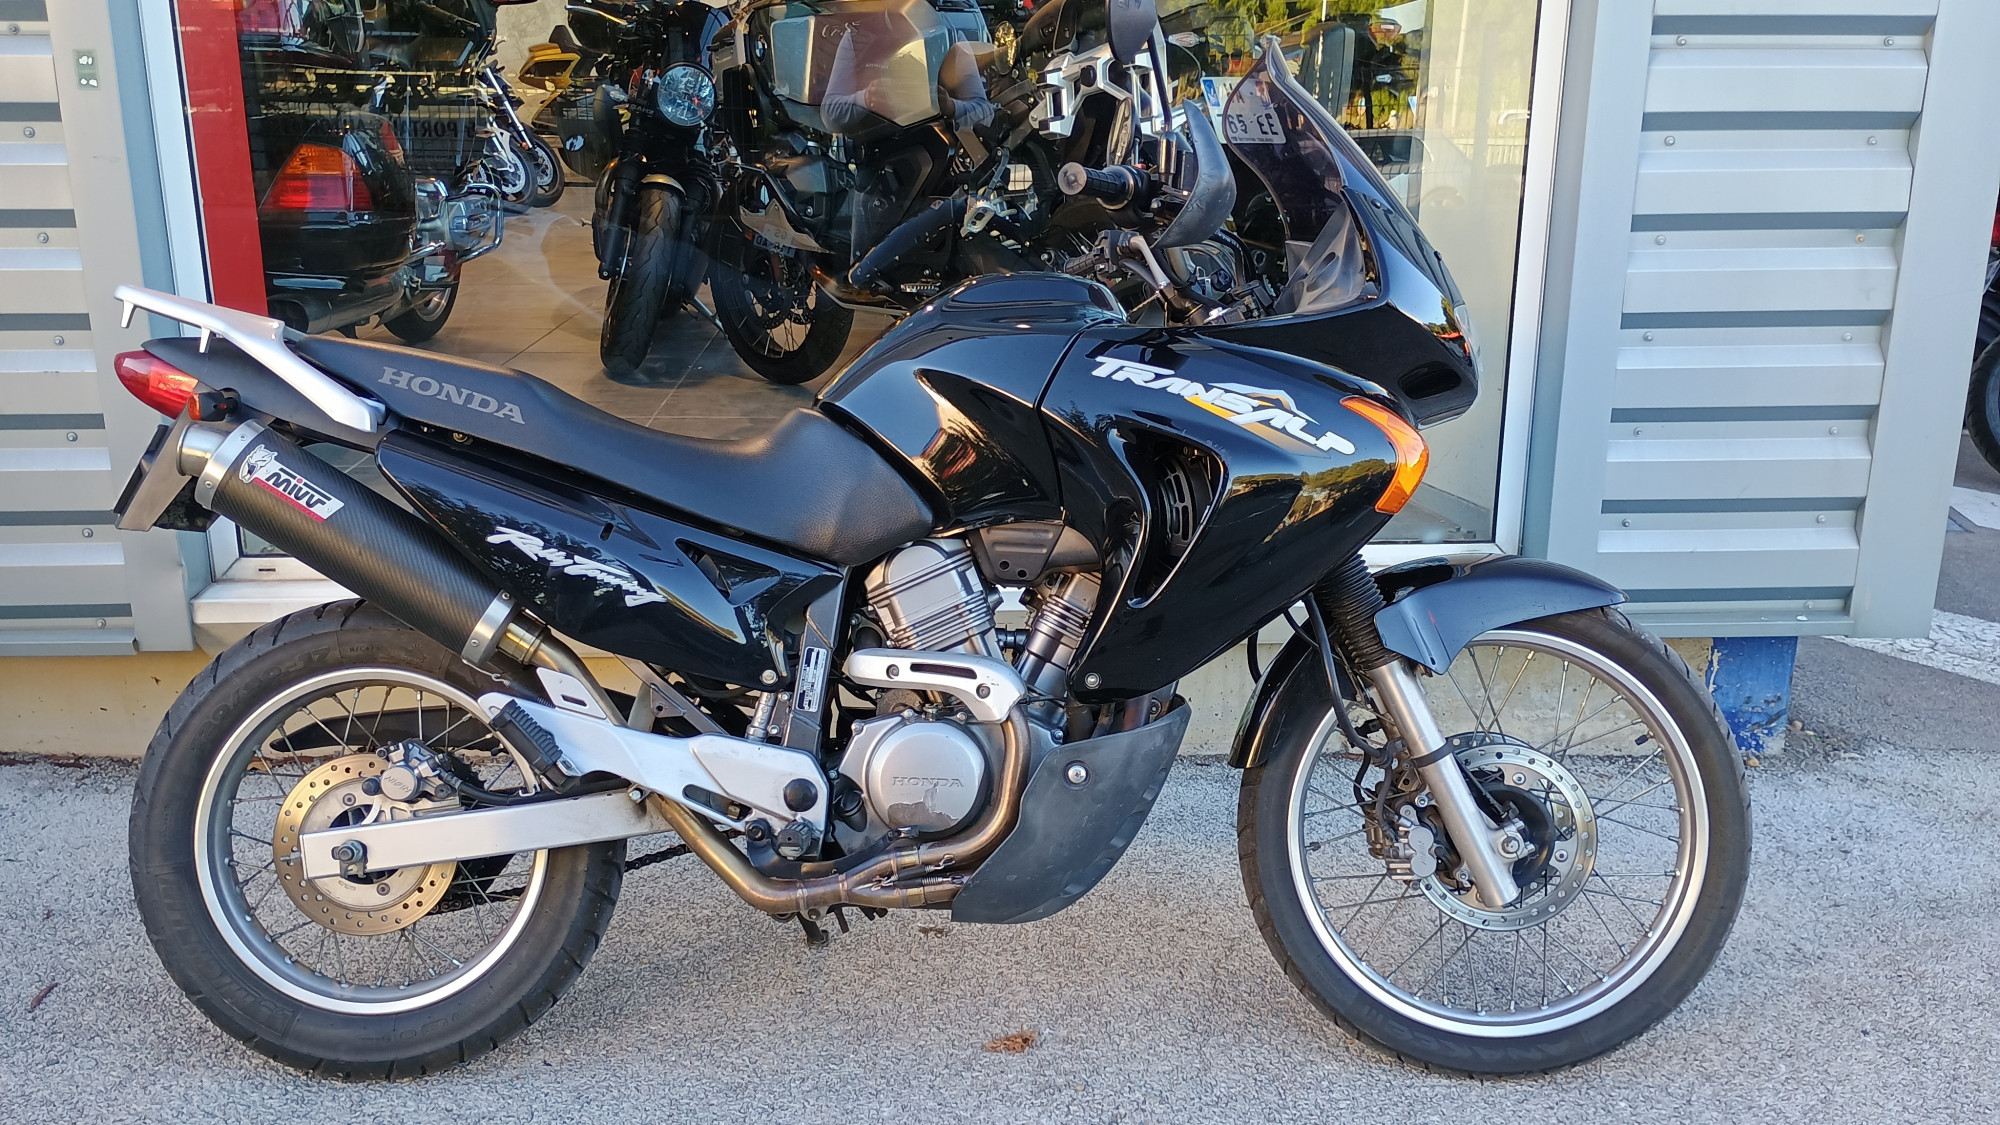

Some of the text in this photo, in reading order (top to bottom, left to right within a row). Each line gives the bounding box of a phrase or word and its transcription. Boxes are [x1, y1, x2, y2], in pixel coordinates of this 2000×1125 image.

[377, 366, 526, 425] HONDA
[1091, 356, 1356, 455] TRANSALP
[892, 776, 966, 788] HONDA
